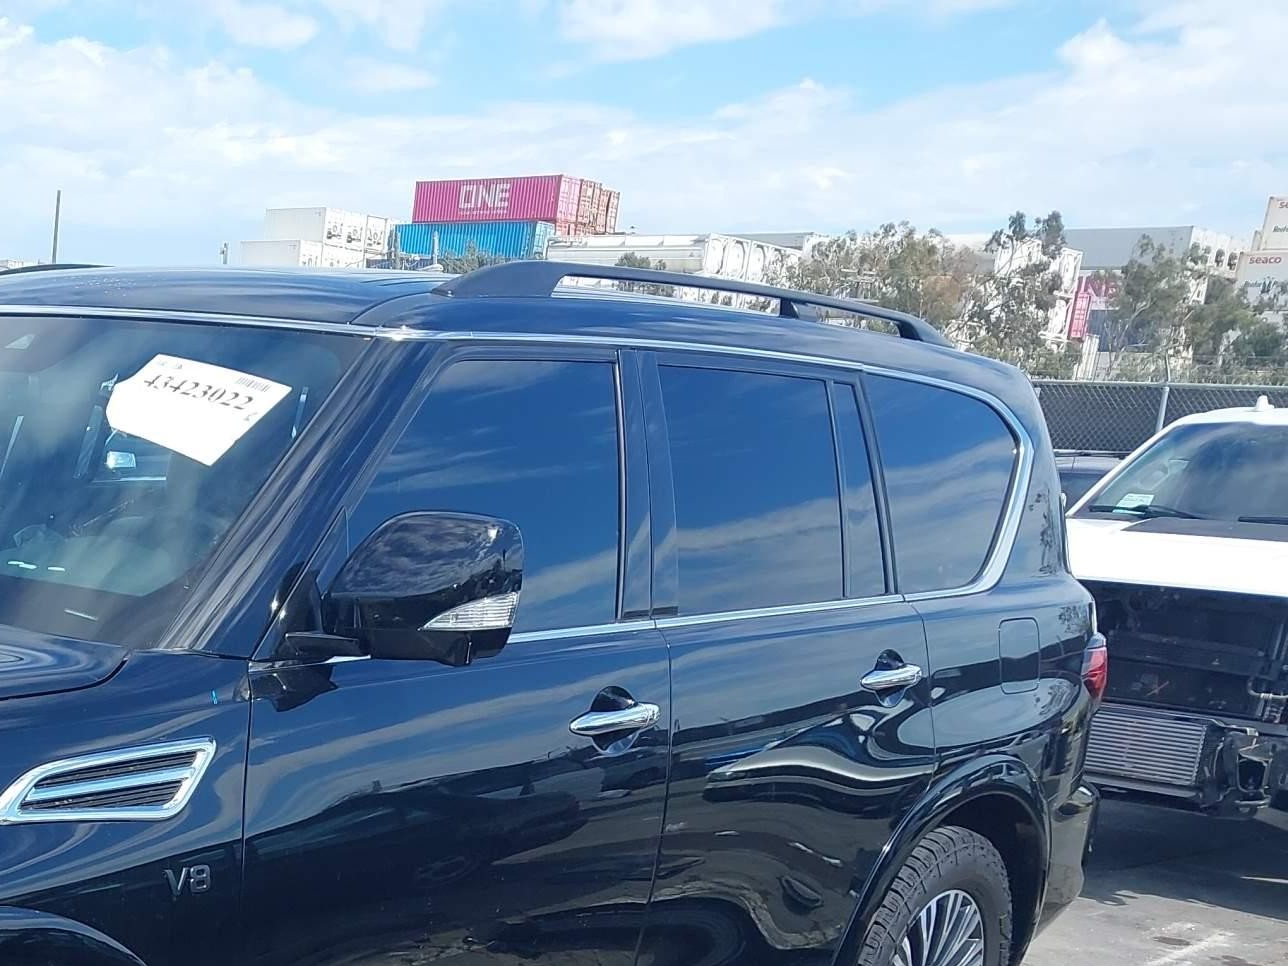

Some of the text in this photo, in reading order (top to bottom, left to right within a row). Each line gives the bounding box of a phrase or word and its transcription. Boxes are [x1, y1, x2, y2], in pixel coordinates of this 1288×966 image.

[459, 183, 510, 210] ONE
[1249, 255, 1281, 264] seaco
[144, 374, 253, 410] 43423022
[163, 864, 211, 896] V8
